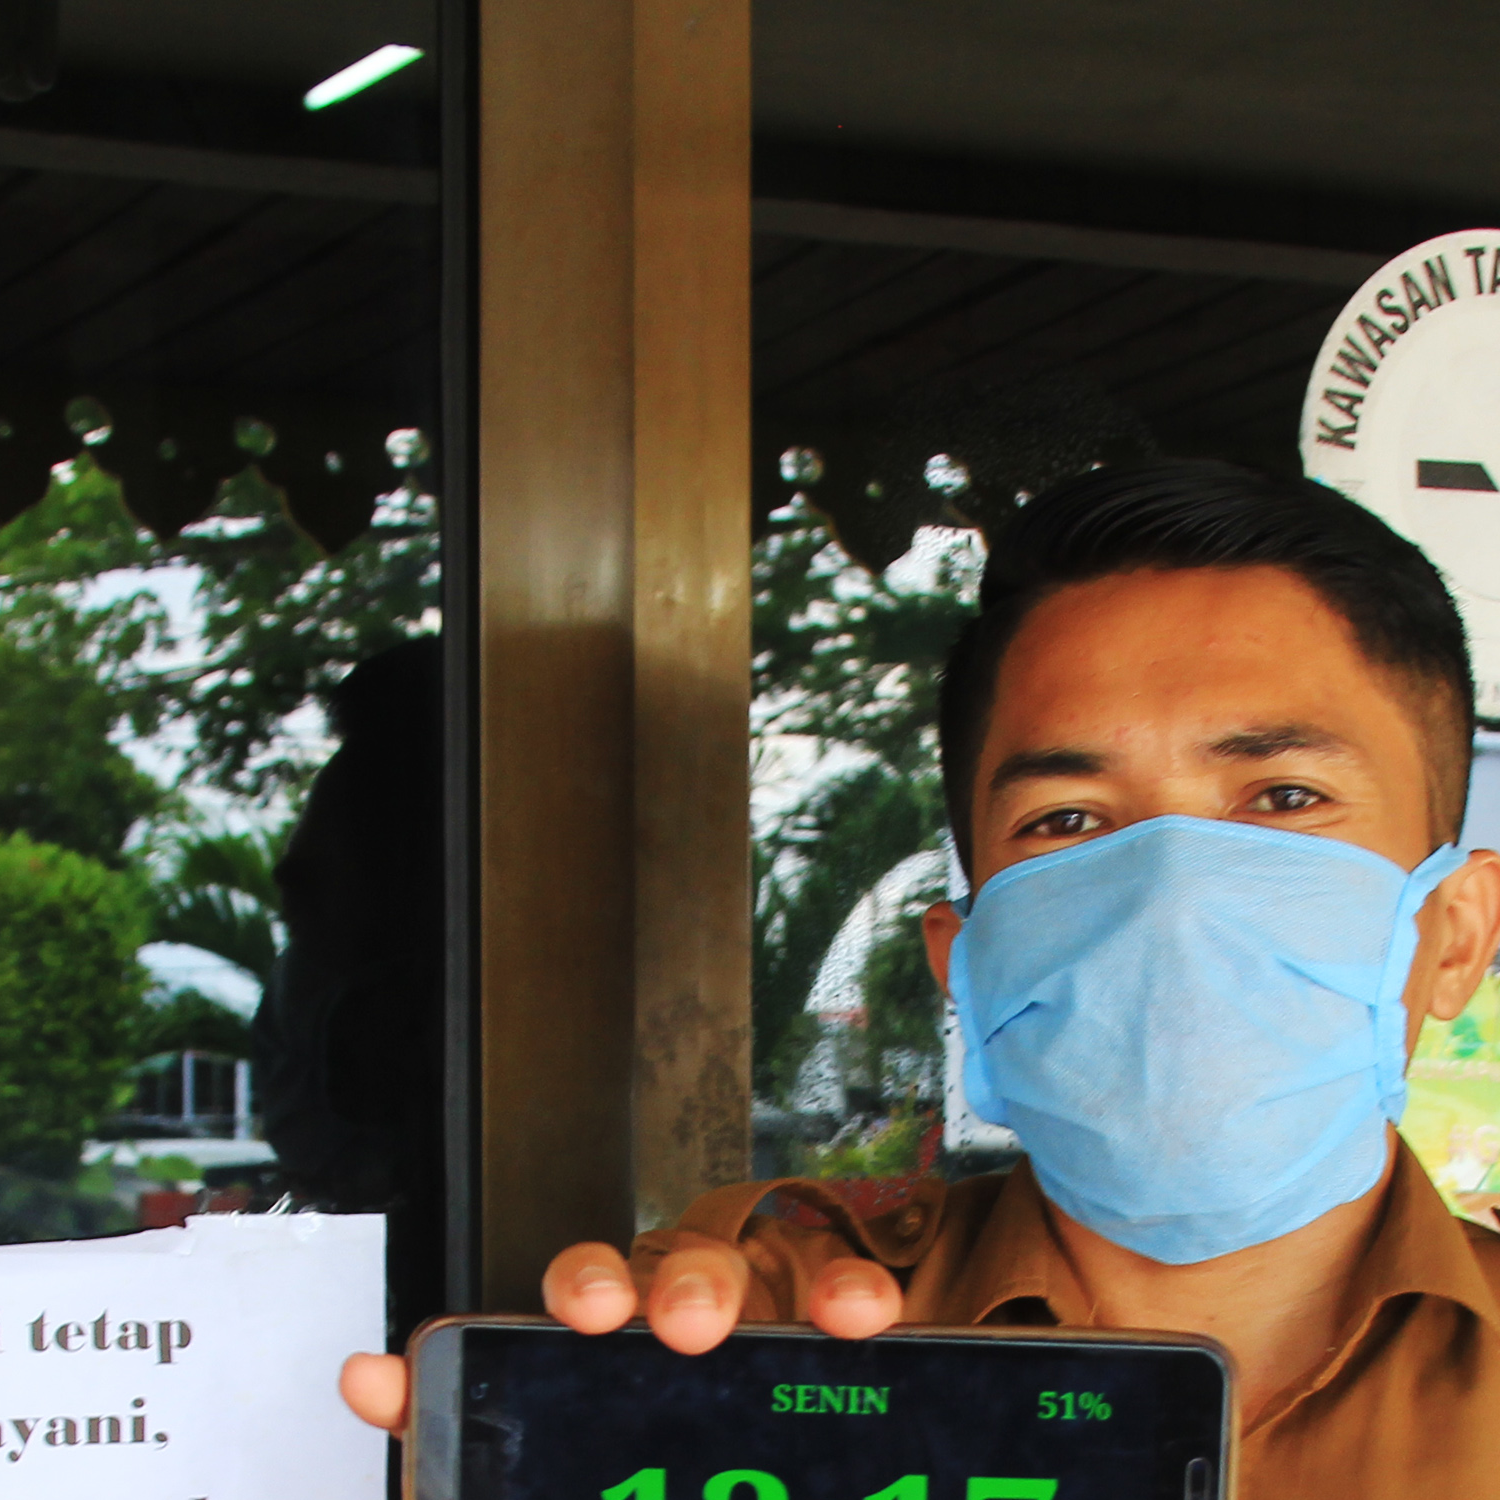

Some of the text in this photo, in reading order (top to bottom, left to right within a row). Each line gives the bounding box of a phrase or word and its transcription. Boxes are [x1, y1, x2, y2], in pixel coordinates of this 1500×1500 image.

[1315, 253, 1458, 451] KAWASAN
[28, 1308, 194, 1367] tetap
[771, 1383, 1112, 1422] SENIN 51%
